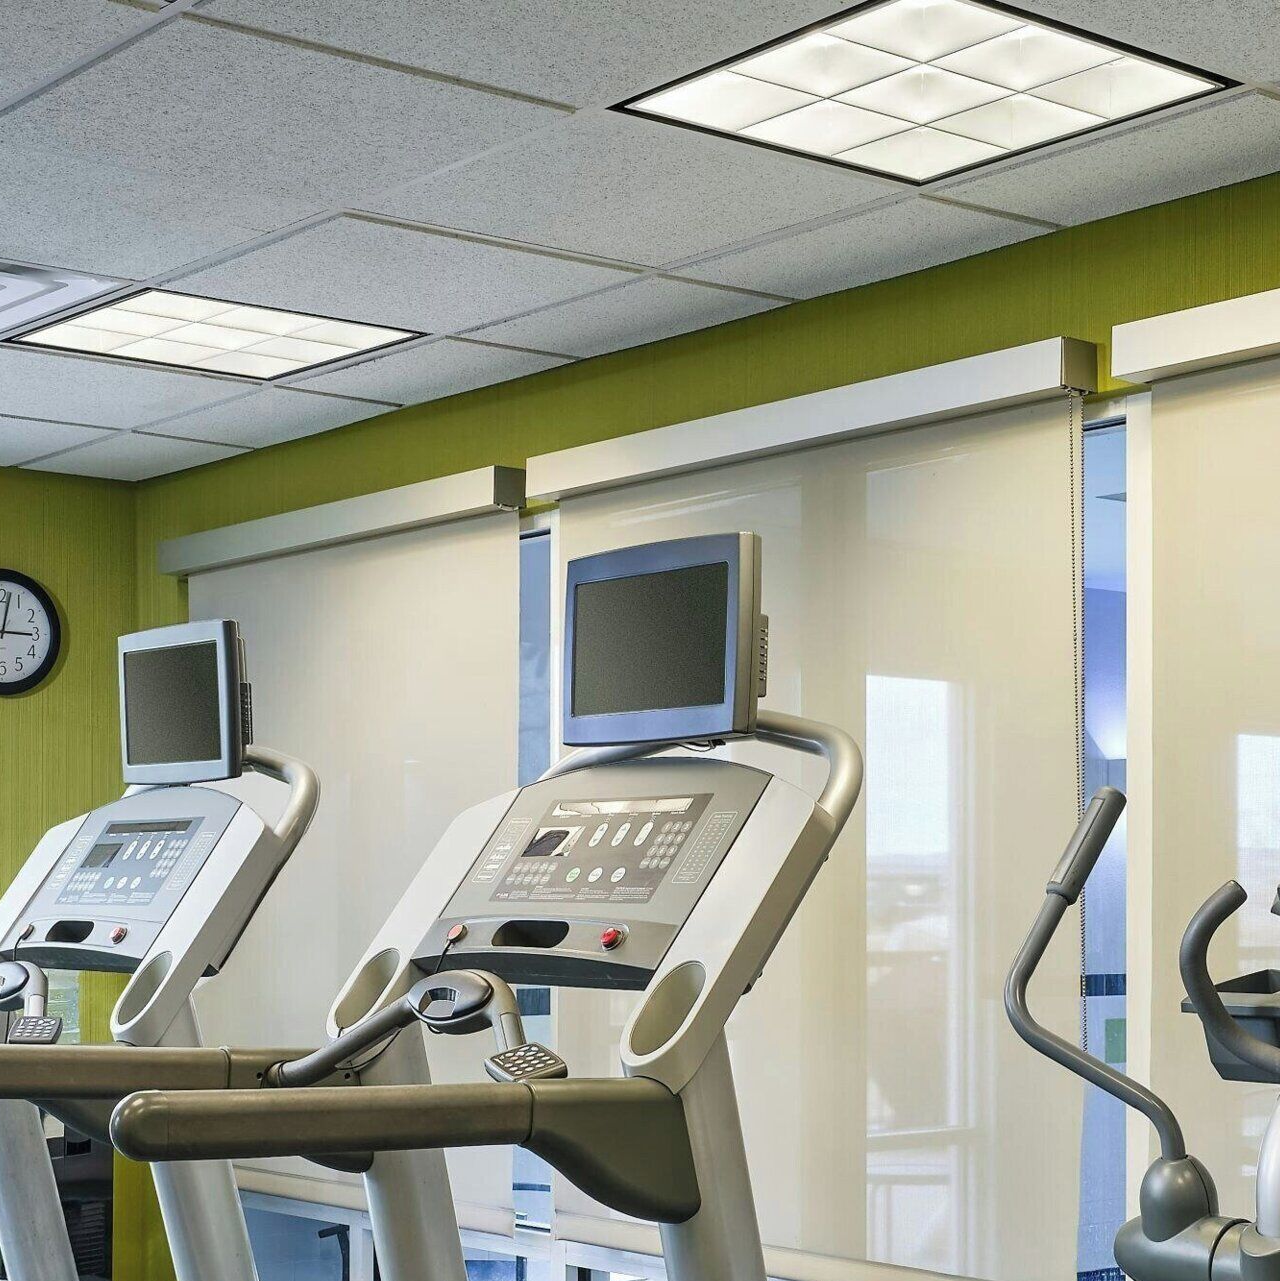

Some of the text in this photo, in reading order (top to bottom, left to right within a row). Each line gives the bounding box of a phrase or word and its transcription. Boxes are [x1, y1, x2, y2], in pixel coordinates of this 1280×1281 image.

[27, 608, 35, 623] 2
[32, 626, 40, 641] 3
[27, 644, 36, 659] 4
[14, 657, 23, 671] 5
